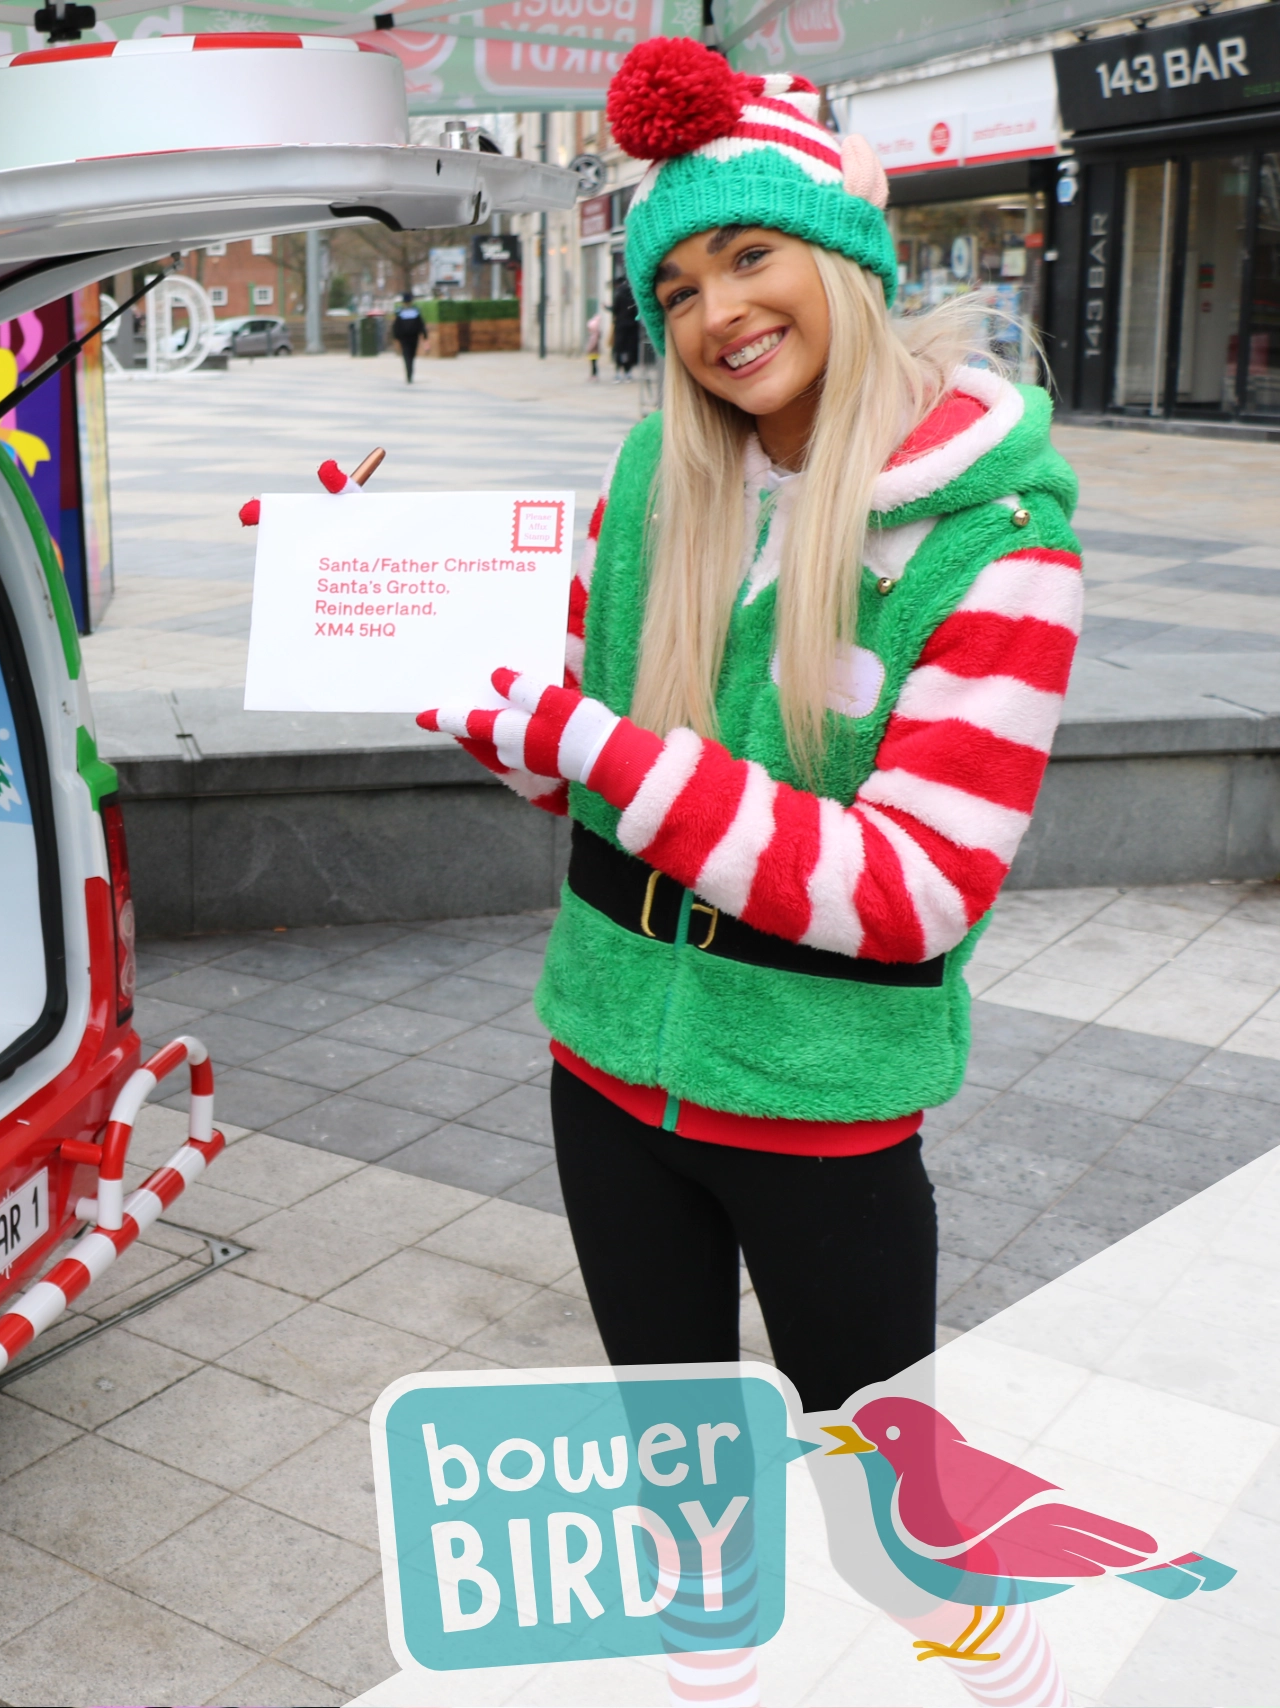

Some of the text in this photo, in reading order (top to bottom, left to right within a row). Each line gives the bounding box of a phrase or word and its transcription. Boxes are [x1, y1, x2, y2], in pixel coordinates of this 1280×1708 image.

[1096, 37, 1250, 99] 143 BAR
[1084, 212, 1109, 359] 143 BAR
[525, 513, 552, 521] Please
[528, 523, 548, 531] Affix
[523, 533, 550, 542] Stamp
[318, 557, 537, 574] Santa/Father Christmas
[317, 578, 451, 595] Santa's Grotto,
[315, 600, 437, 617] Reindeerland,
[314, 622, 397, 638] XM4 5HQ
[32, 1185, 39, 1229] 1
